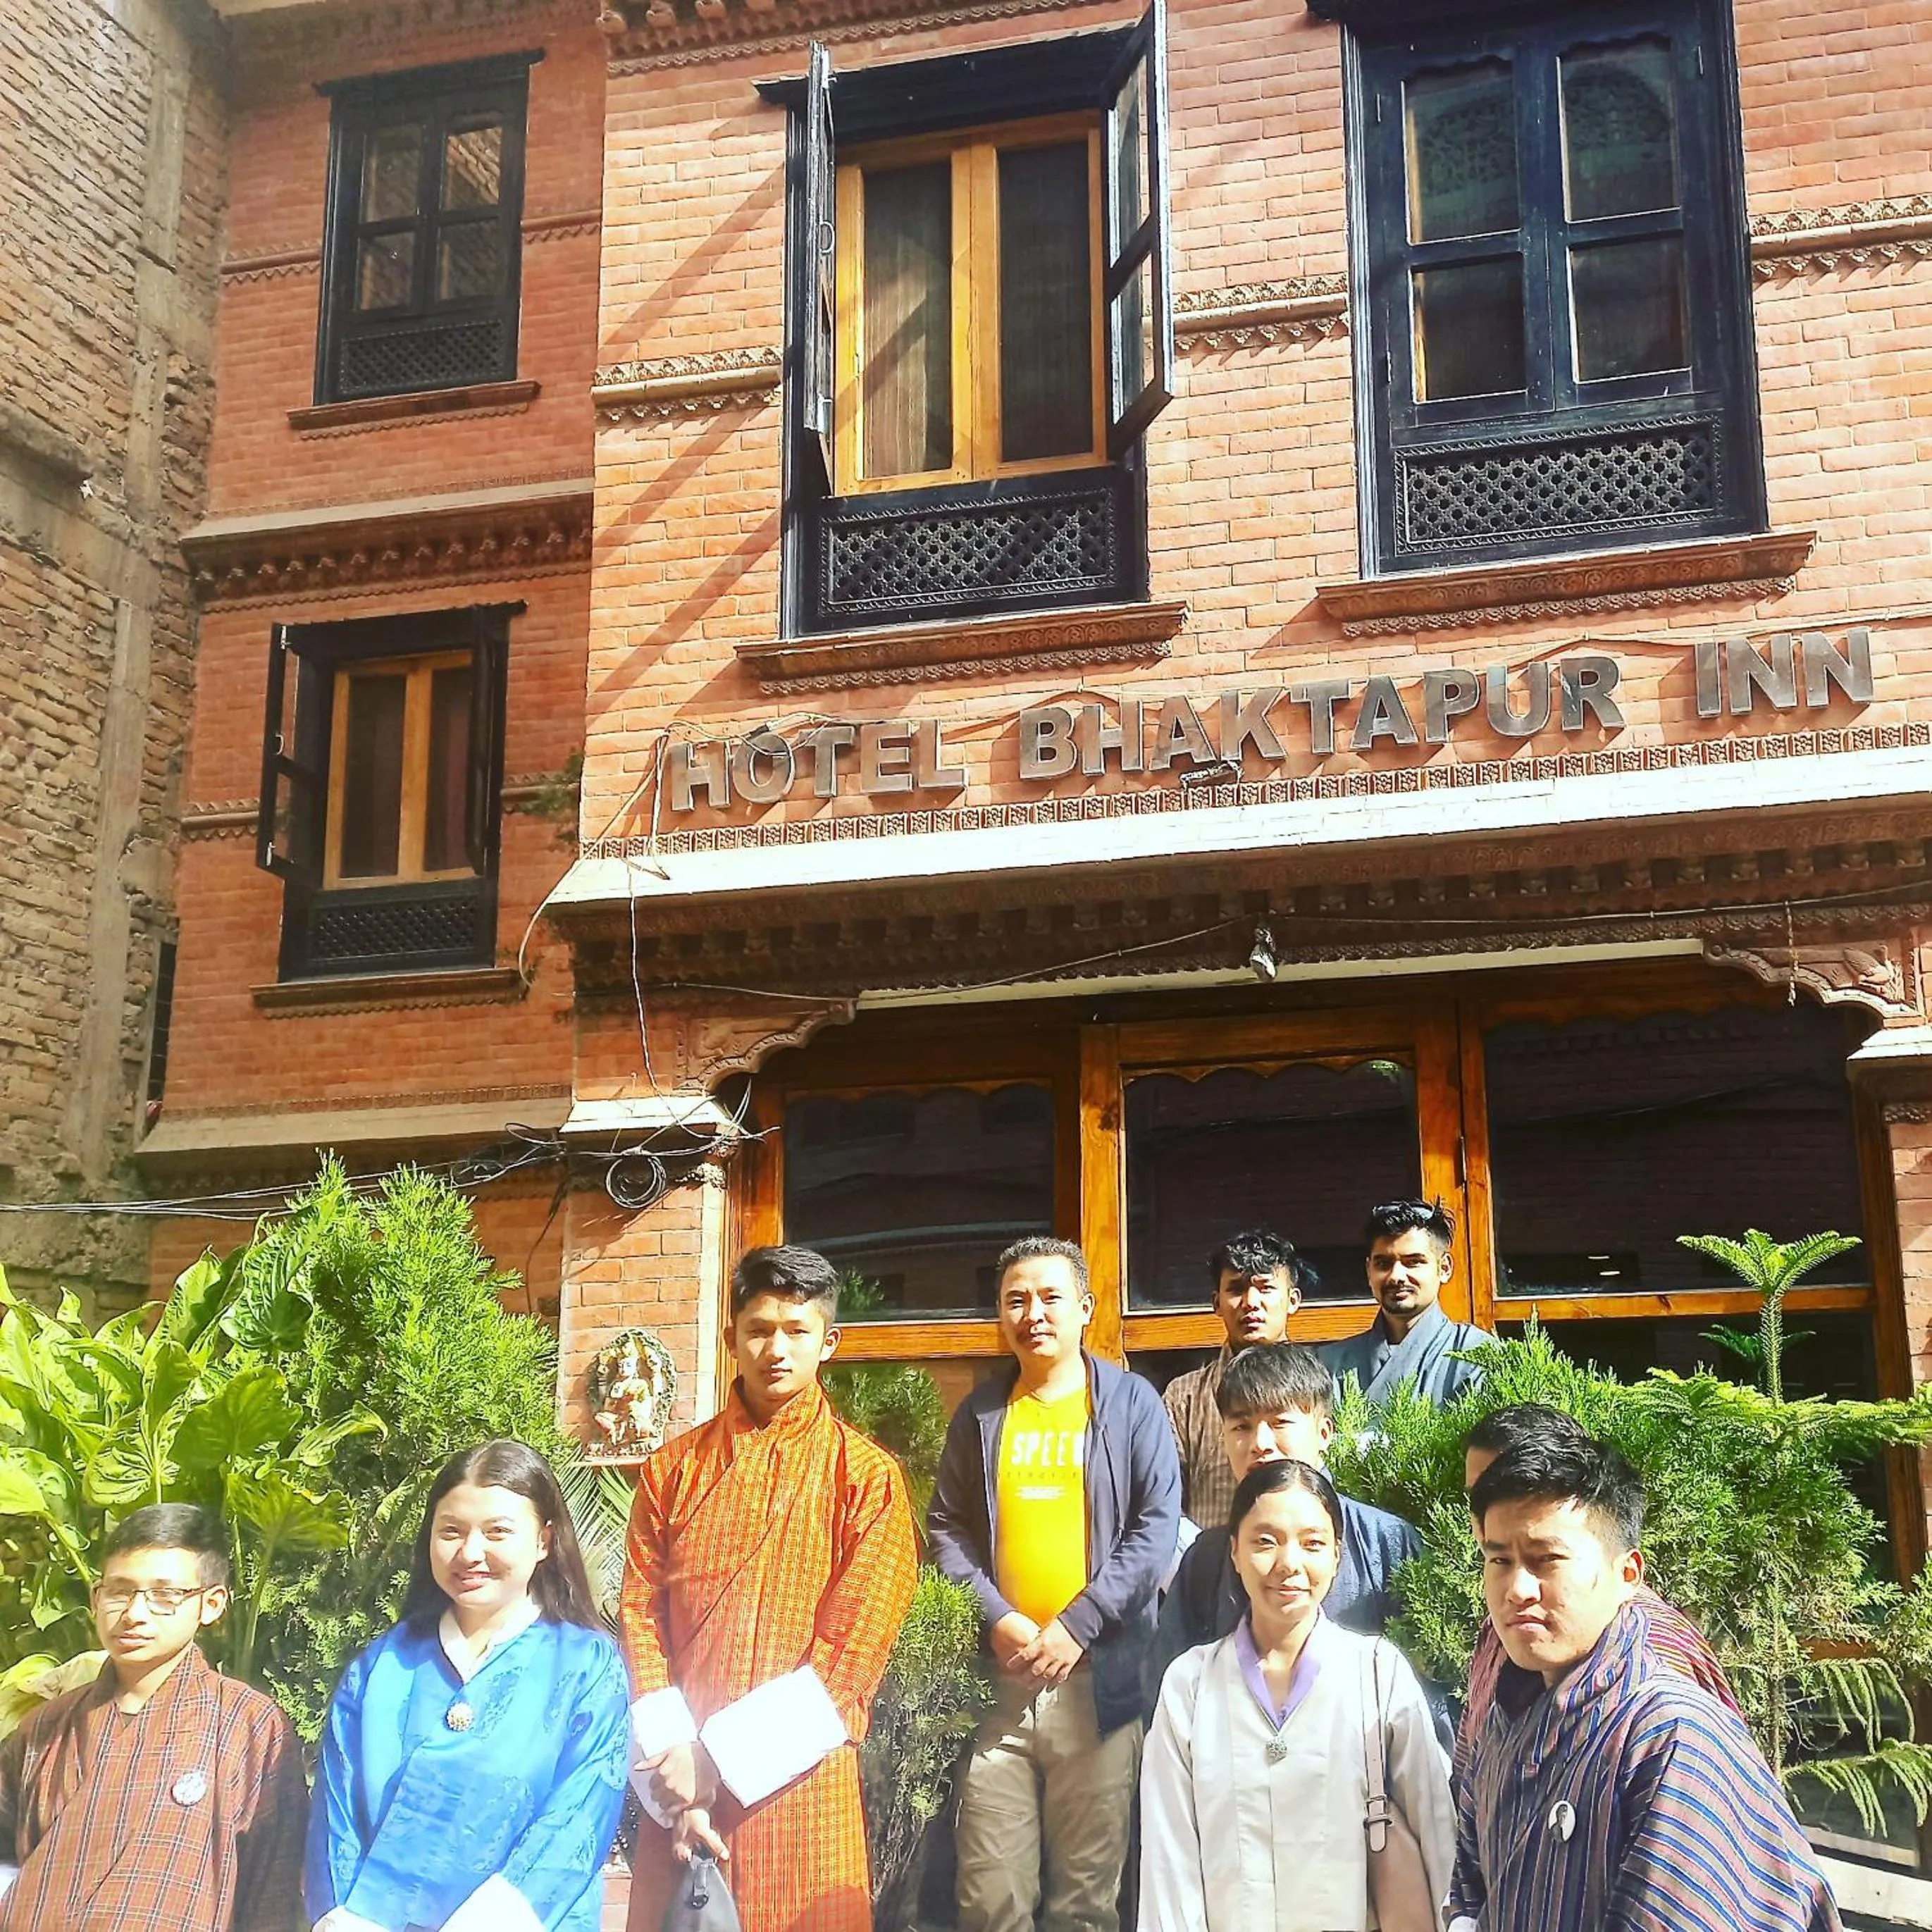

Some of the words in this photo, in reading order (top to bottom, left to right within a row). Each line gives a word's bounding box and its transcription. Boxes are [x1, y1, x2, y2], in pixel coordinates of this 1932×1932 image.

[669, 719, 967, 812] HOTEL
[1020, 655, 1626, 780] BHAKTAPUR
[1695, 626, 1874, 717] INN
